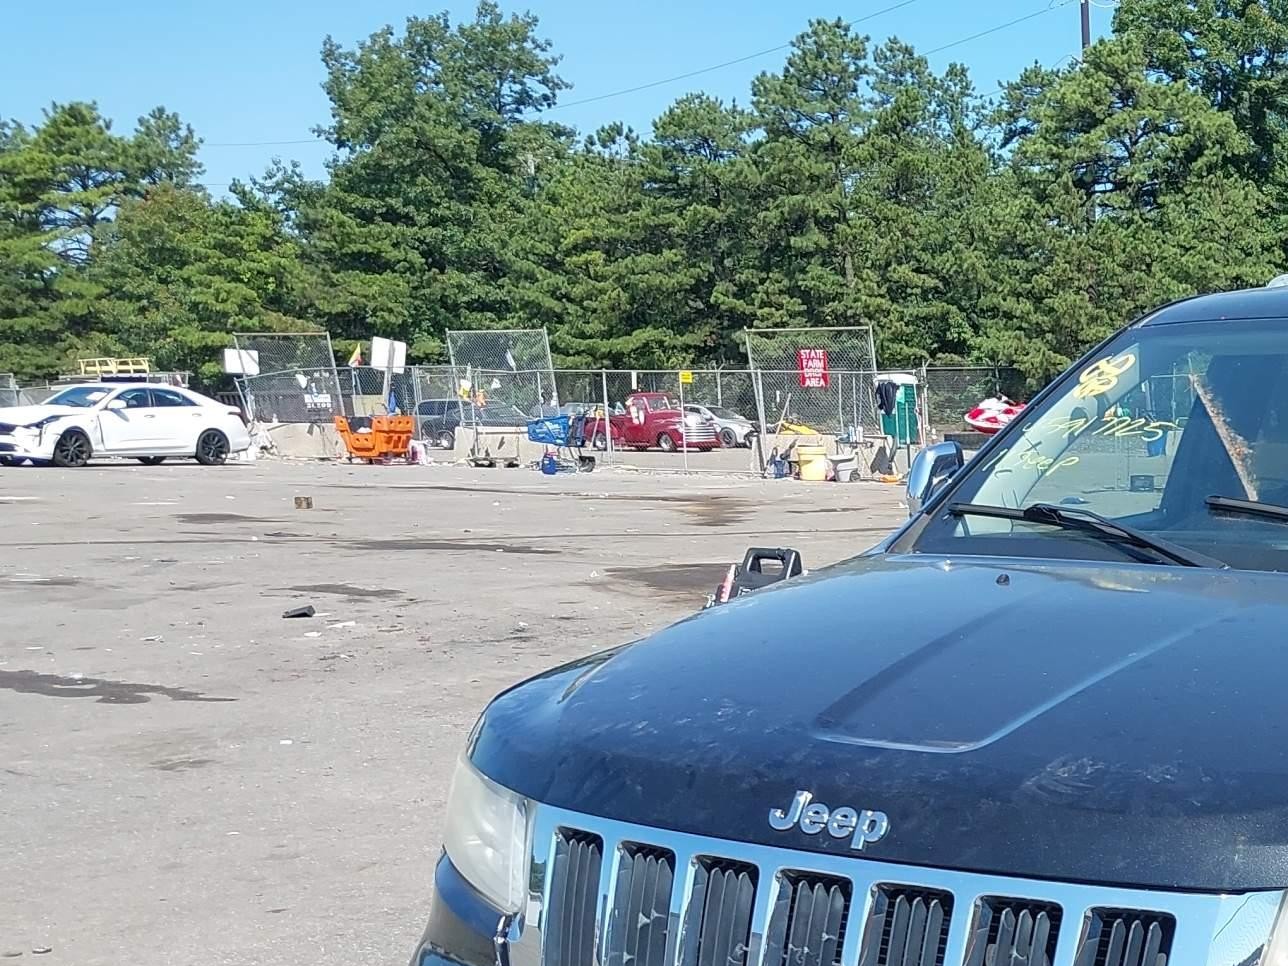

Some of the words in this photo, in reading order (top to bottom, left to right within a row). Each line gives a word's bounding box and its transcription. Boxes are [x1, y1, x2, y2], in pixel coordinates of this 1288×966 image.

[800, 349, 825, 359] STATE
[802, 359, 825, 369] FARM
[804, 377, 826, 388] AREA
[768, 790, 889, 850] Jeep
